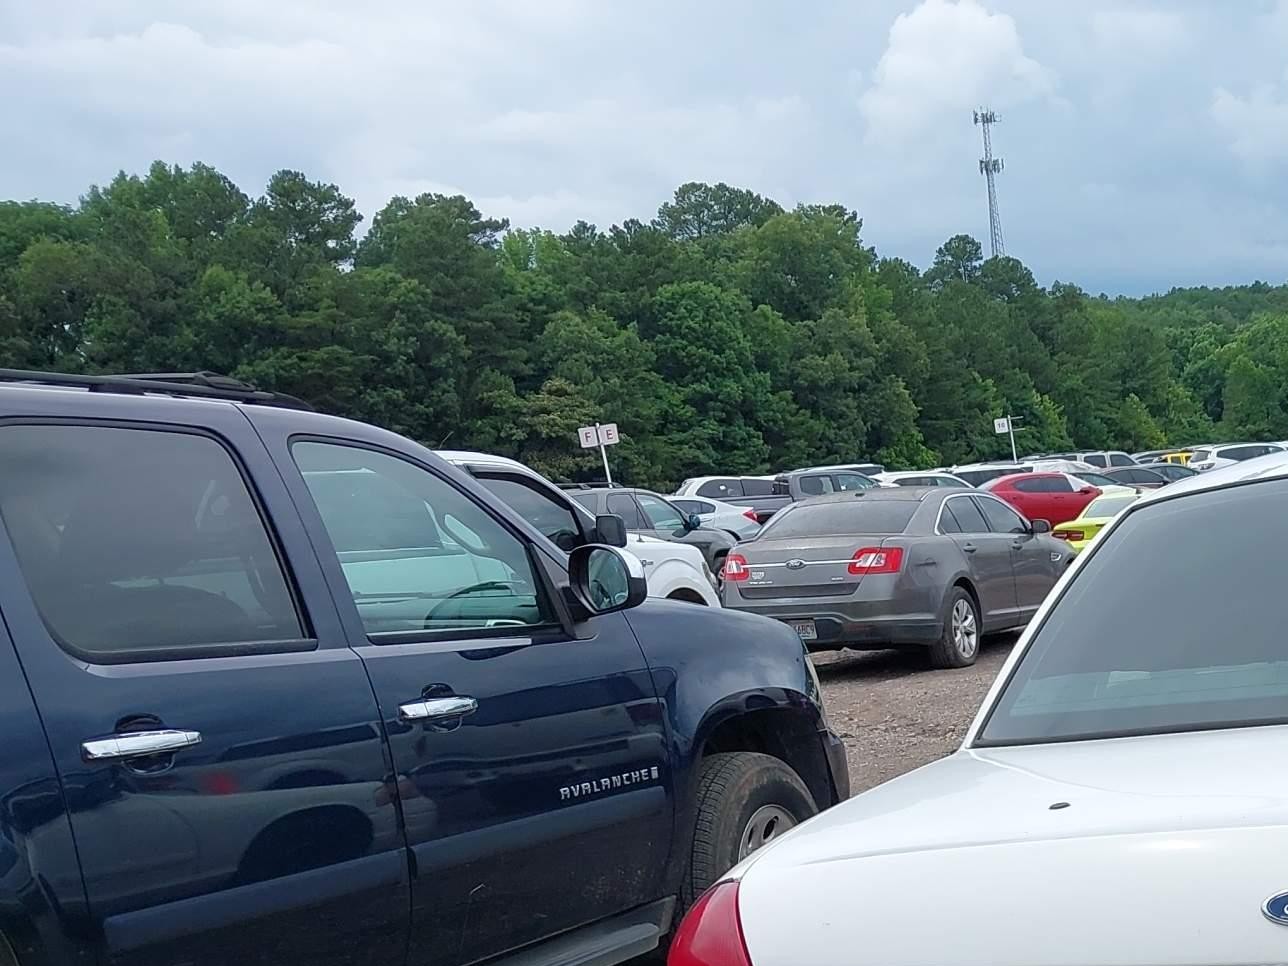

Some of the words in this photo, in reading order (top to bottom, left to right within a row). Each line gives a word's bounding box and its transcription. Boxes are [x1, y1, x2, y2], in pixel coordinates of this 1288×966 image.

[584, 431, 592, 442] F
[605, 429, 614, 440] E
[559, 768, 650, 800] AVALANCHE
